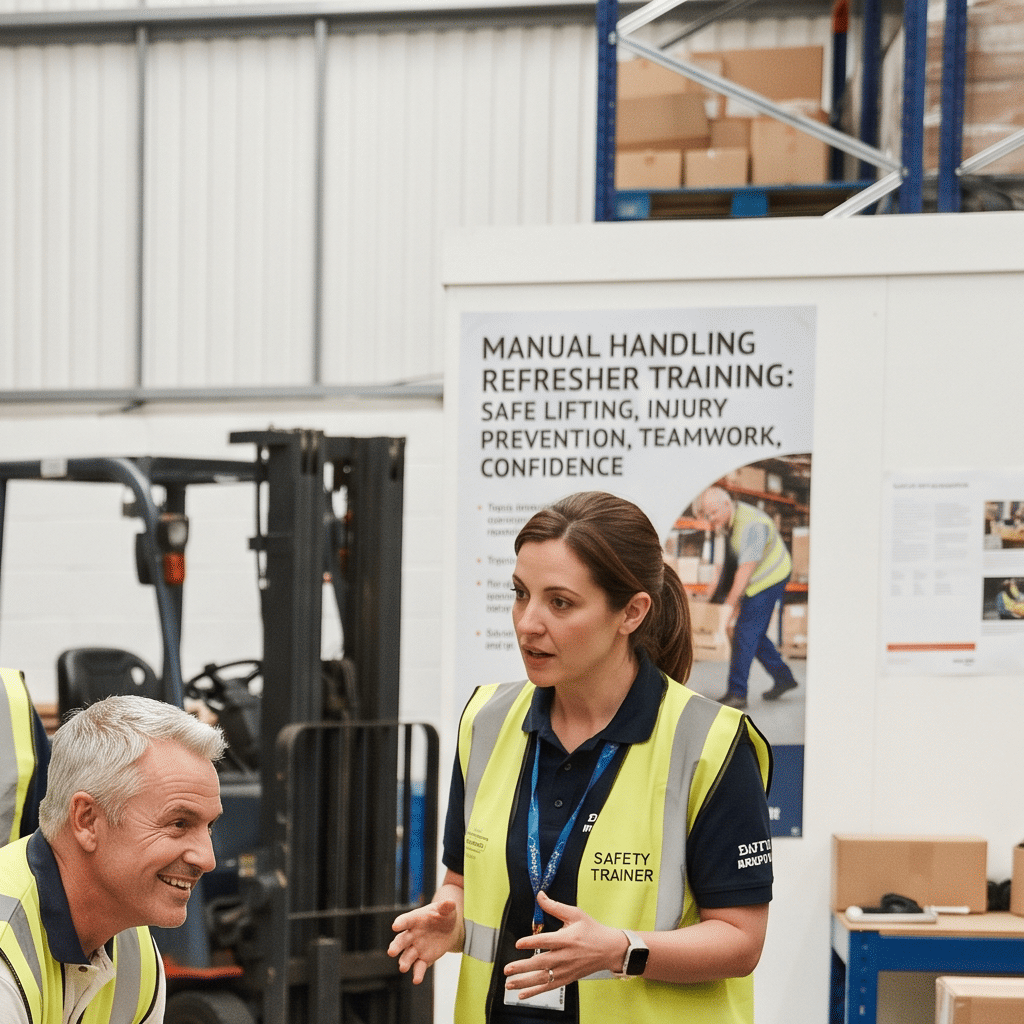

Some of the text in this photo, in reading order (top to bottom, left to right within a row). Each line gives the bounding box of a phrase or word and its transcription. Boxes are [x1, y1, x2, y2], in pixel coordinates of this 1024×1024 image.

[482, 331, 756, 360] MANUAL HANDLING
[482, 363, 794, 392] REFRESHER TRAINING:
[481, 398, 728, 422] SAFE LIFTING, INJURY
[481, 425, 782, 450] PREVENTION, TEAMWORK,
[481, 456, 624, 478] CONFIDENCE
[593, 851, 651, 866] SAFETY
[590, 867, 655, 883] TRAINER
